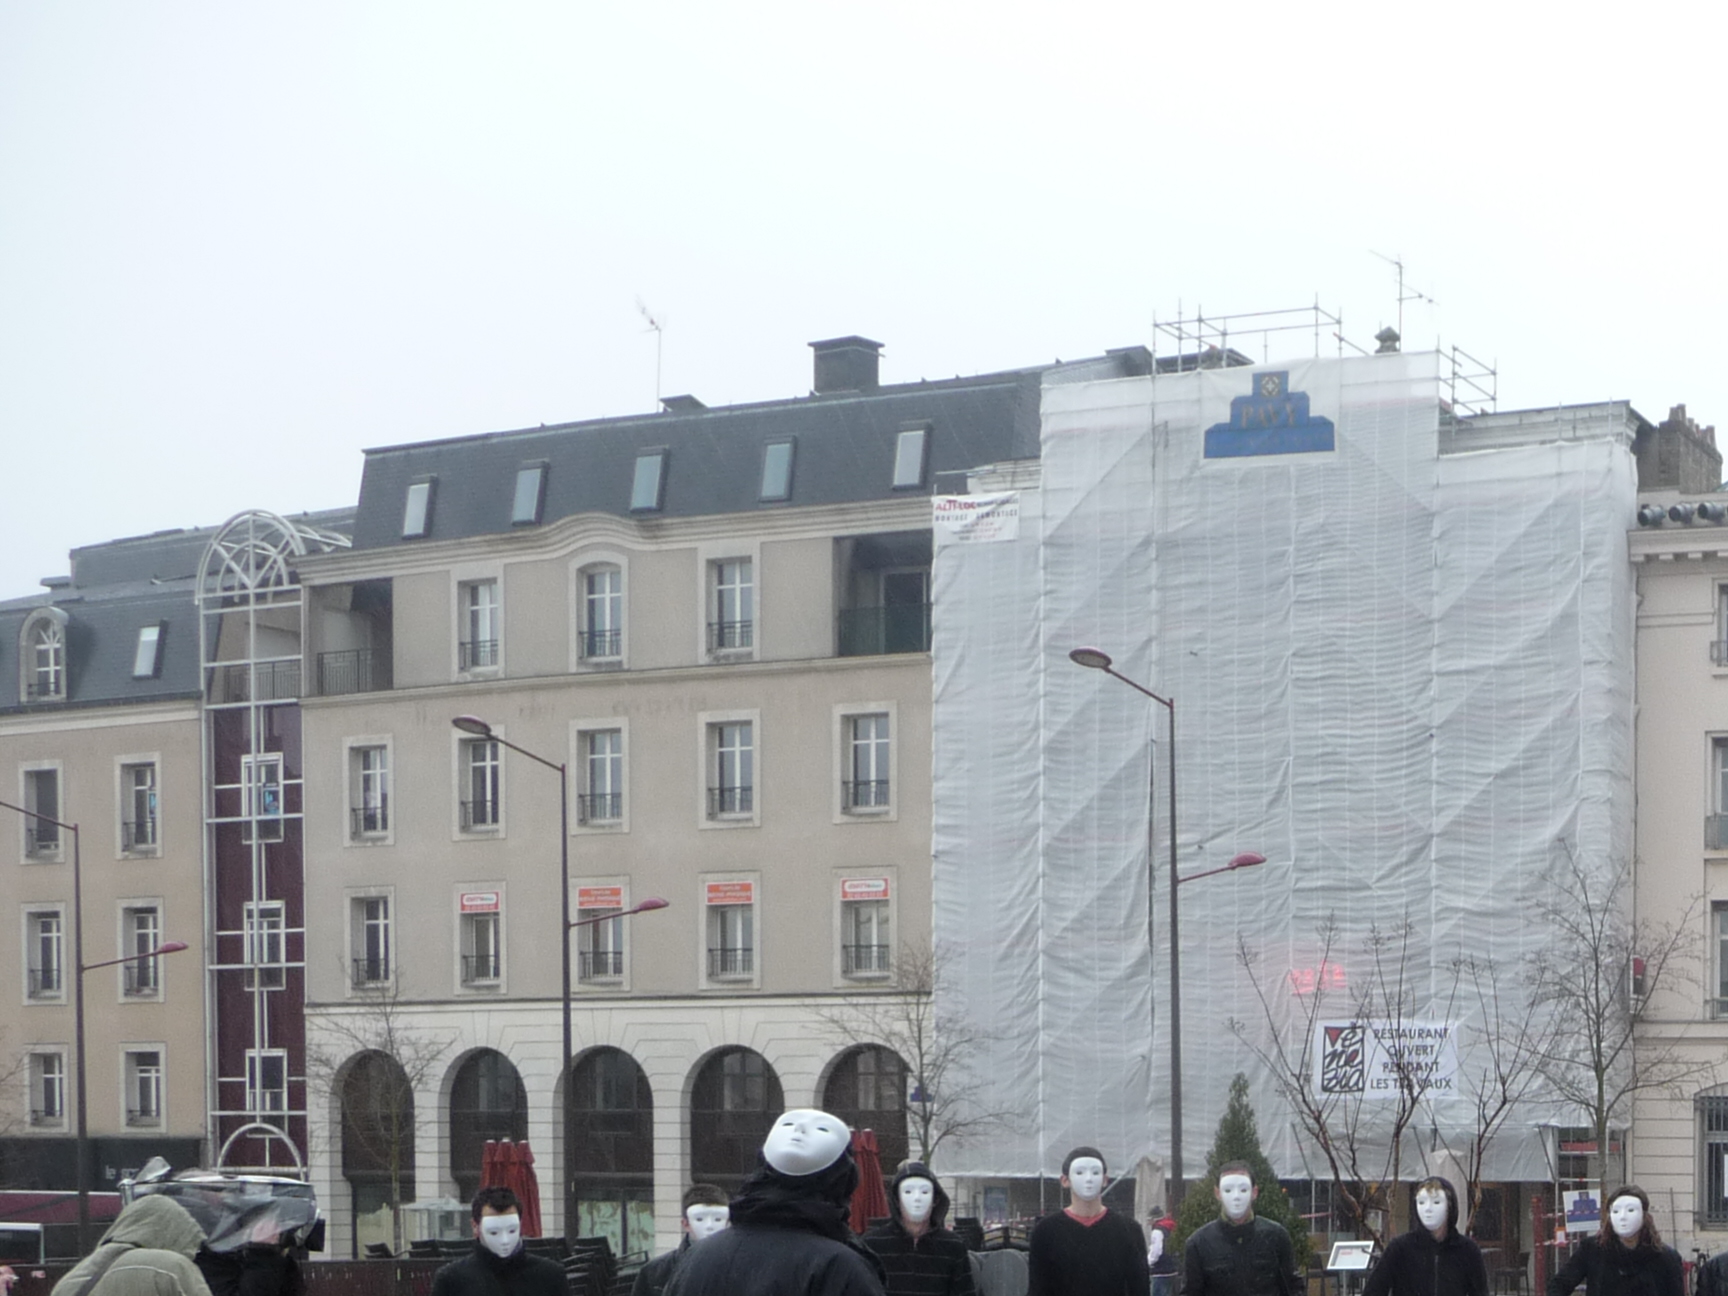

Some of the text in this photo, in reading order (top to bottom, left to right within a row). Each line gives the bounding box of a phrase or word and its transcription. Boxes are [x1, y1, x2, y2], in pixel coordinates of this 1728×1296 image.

[1374, 1028, 1449, 1040] RESTAURANT
[1387, 1045, 1435, 1056] OUVERT
[1382, 1062, 1440, 1073] PENDANT
[1370, 1078, 1389, 1090] LES
